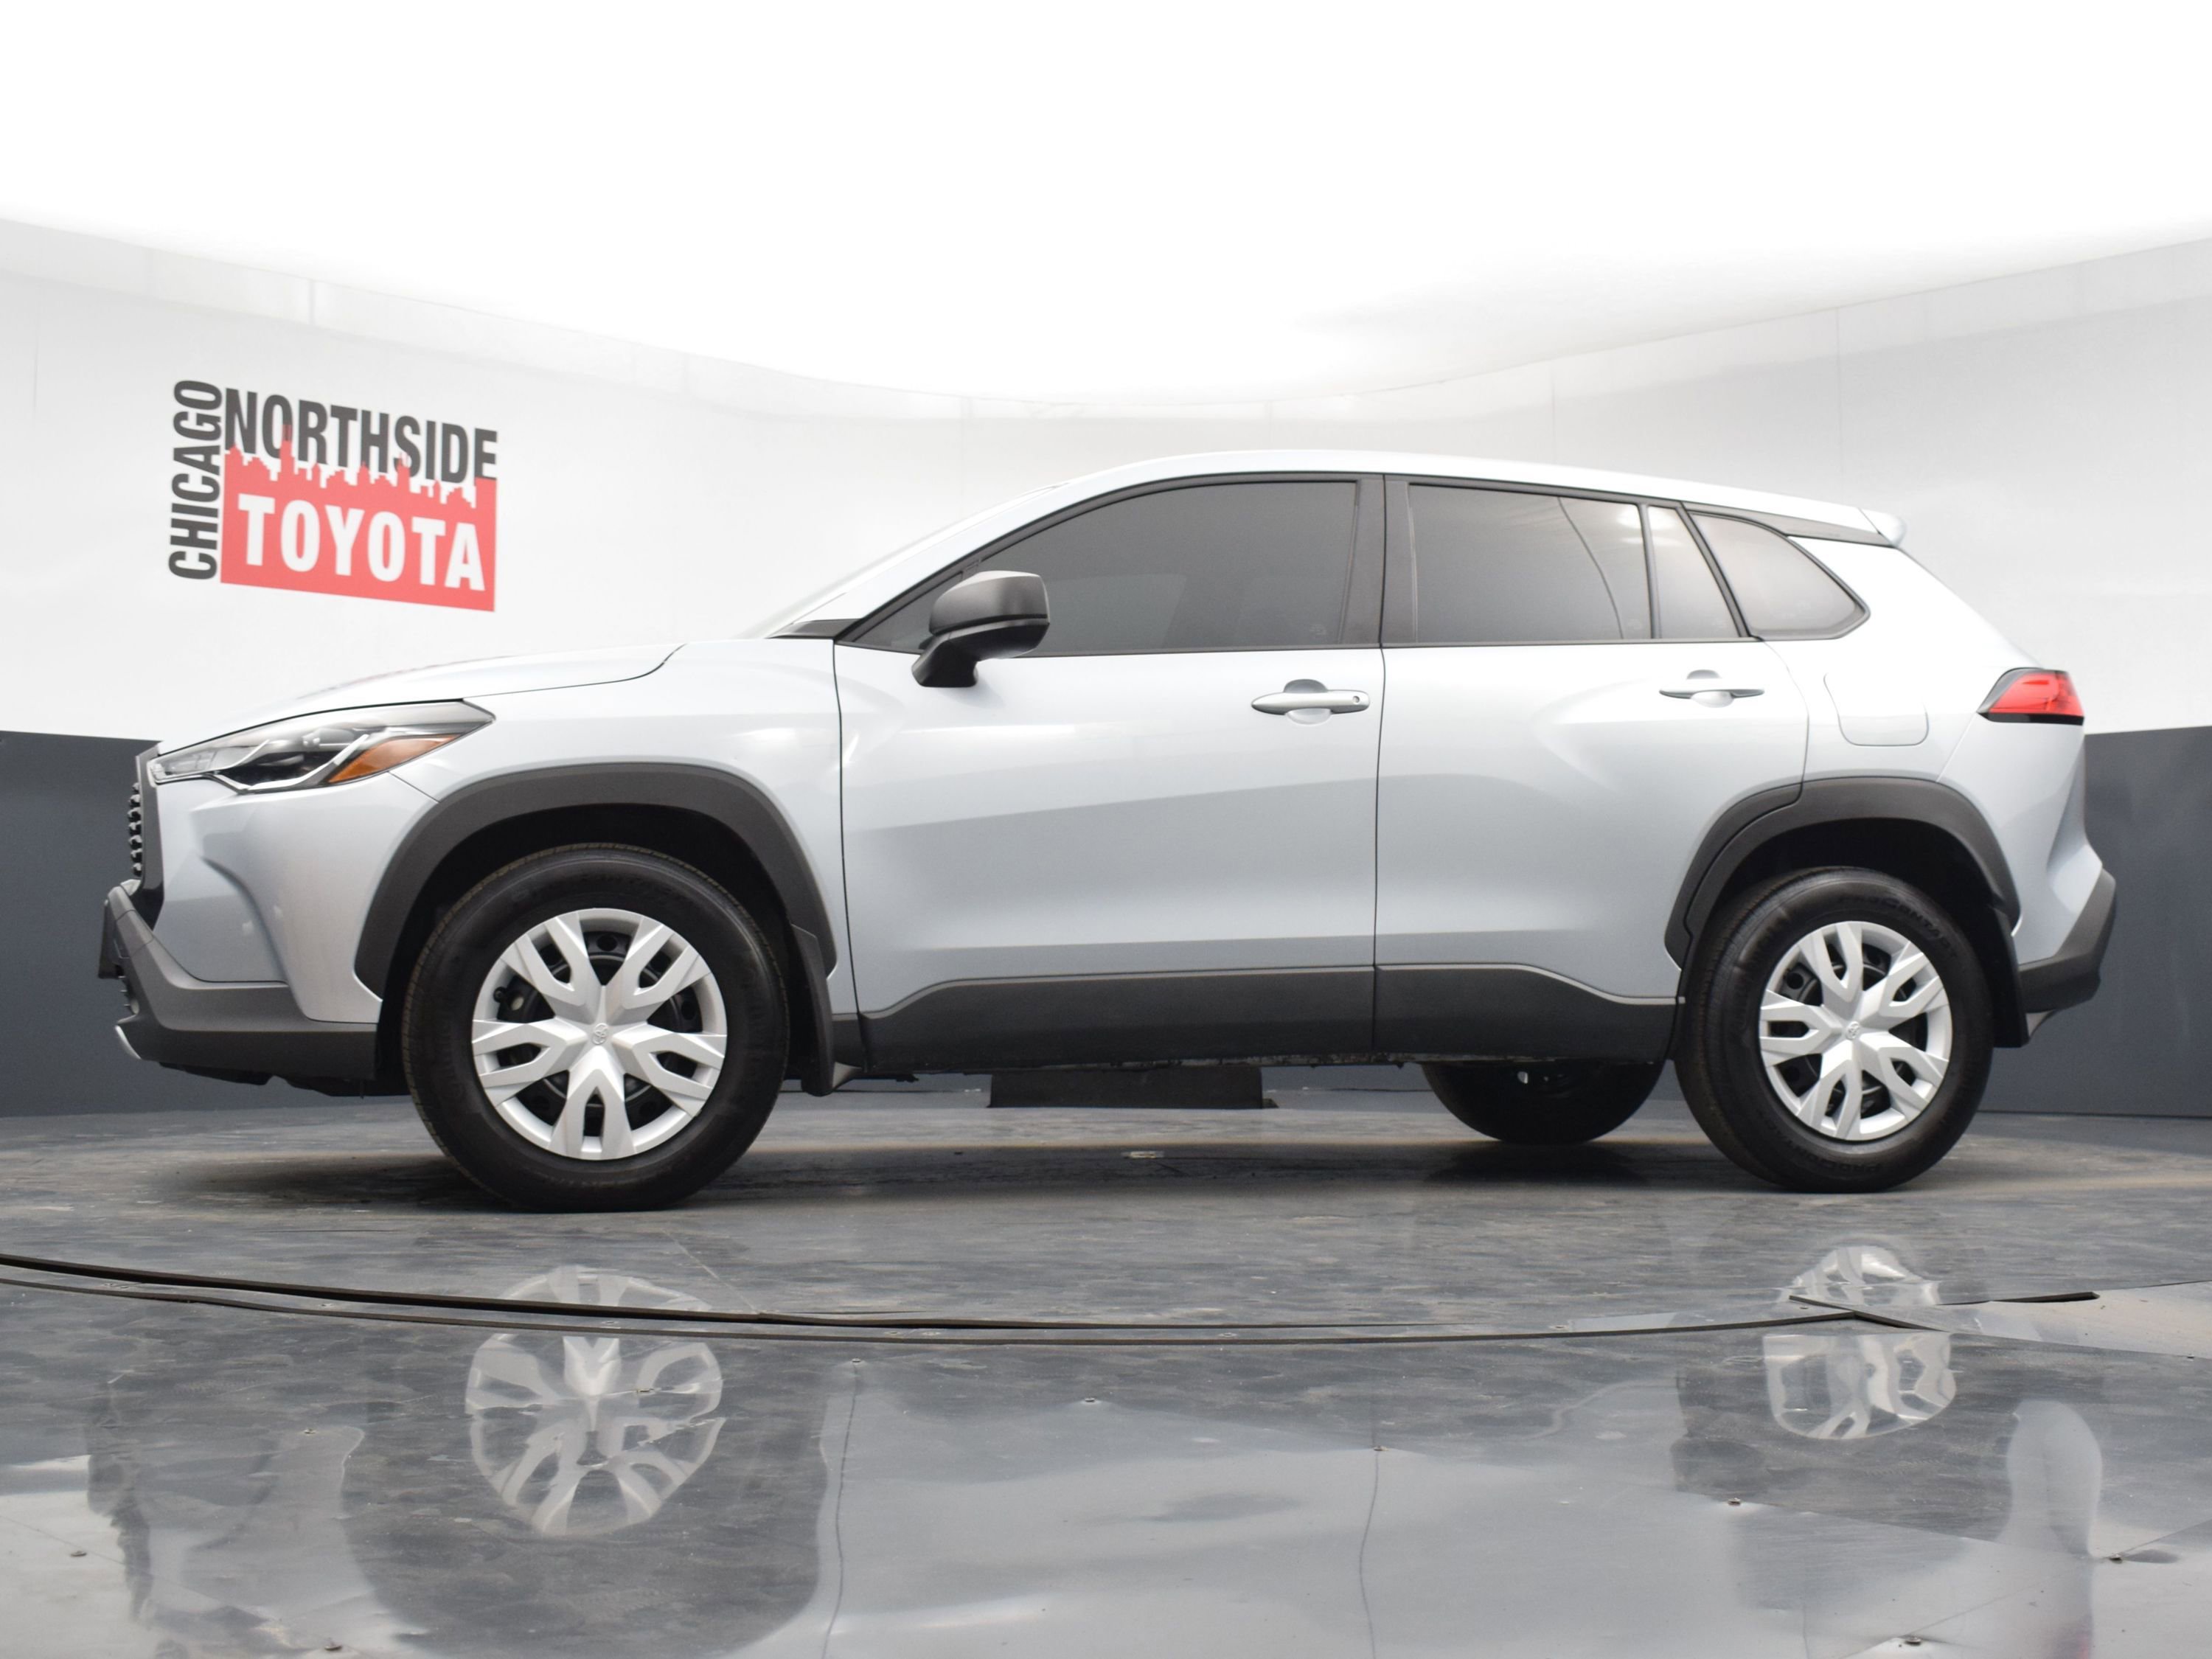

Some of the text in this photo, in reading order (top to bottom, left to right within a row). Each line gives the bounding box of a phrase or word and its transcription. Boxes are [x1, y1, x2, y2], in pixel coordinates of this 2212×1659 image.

[168, 379, 222, 580] CHICAGO
[224, 387, 498, 485] NORTHSIDE
[237, 493, 486, 592] TOYOTA
